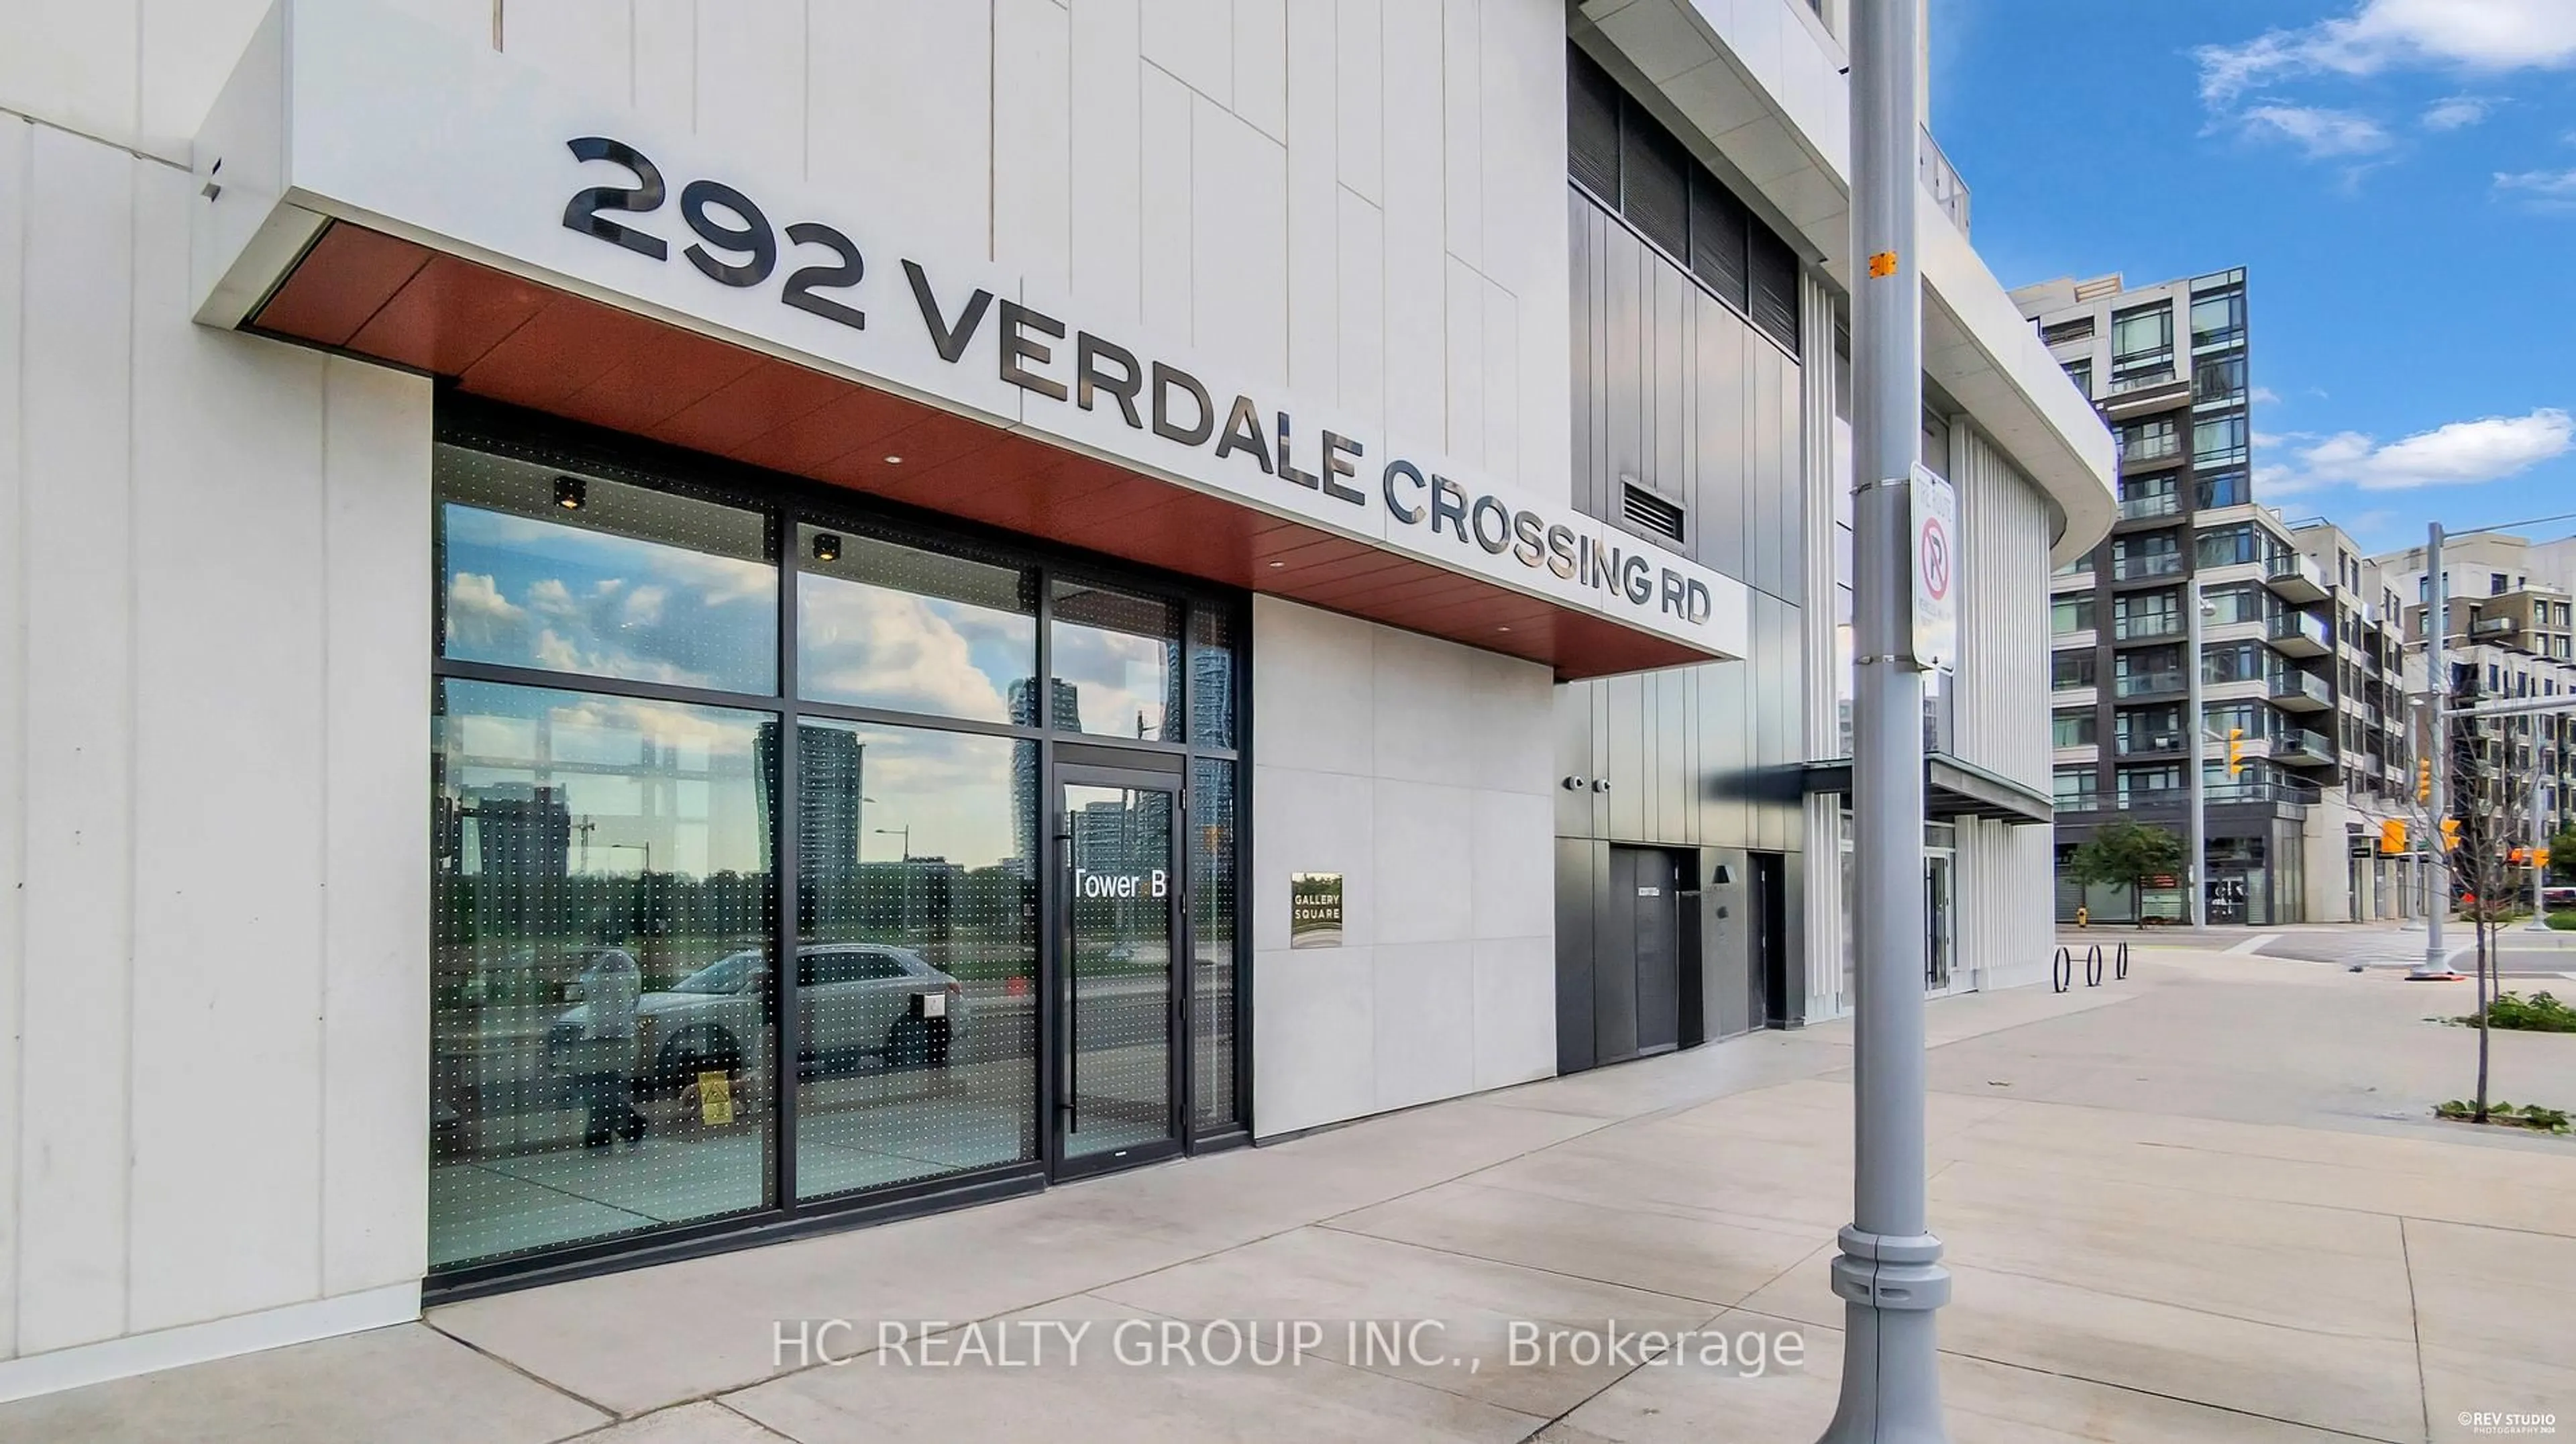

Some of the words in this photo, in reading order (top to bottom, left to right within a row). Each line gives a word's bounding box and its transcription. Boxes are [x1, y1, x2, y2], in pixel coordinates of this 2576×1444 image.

[564, 136, 865, 330] 292
[901, 258, 1366, 506] VERDALE
[1383, 460, 1653, 605] CROSSING
[1661, 568, 1711, 625] RD
[1075, 868, 1139, 898] Tower
[1152, 869, 1167, 898] B
[1295, 894, 1340, 905] GALLERY
[1295, 909, 1340, 919] SQUARE
